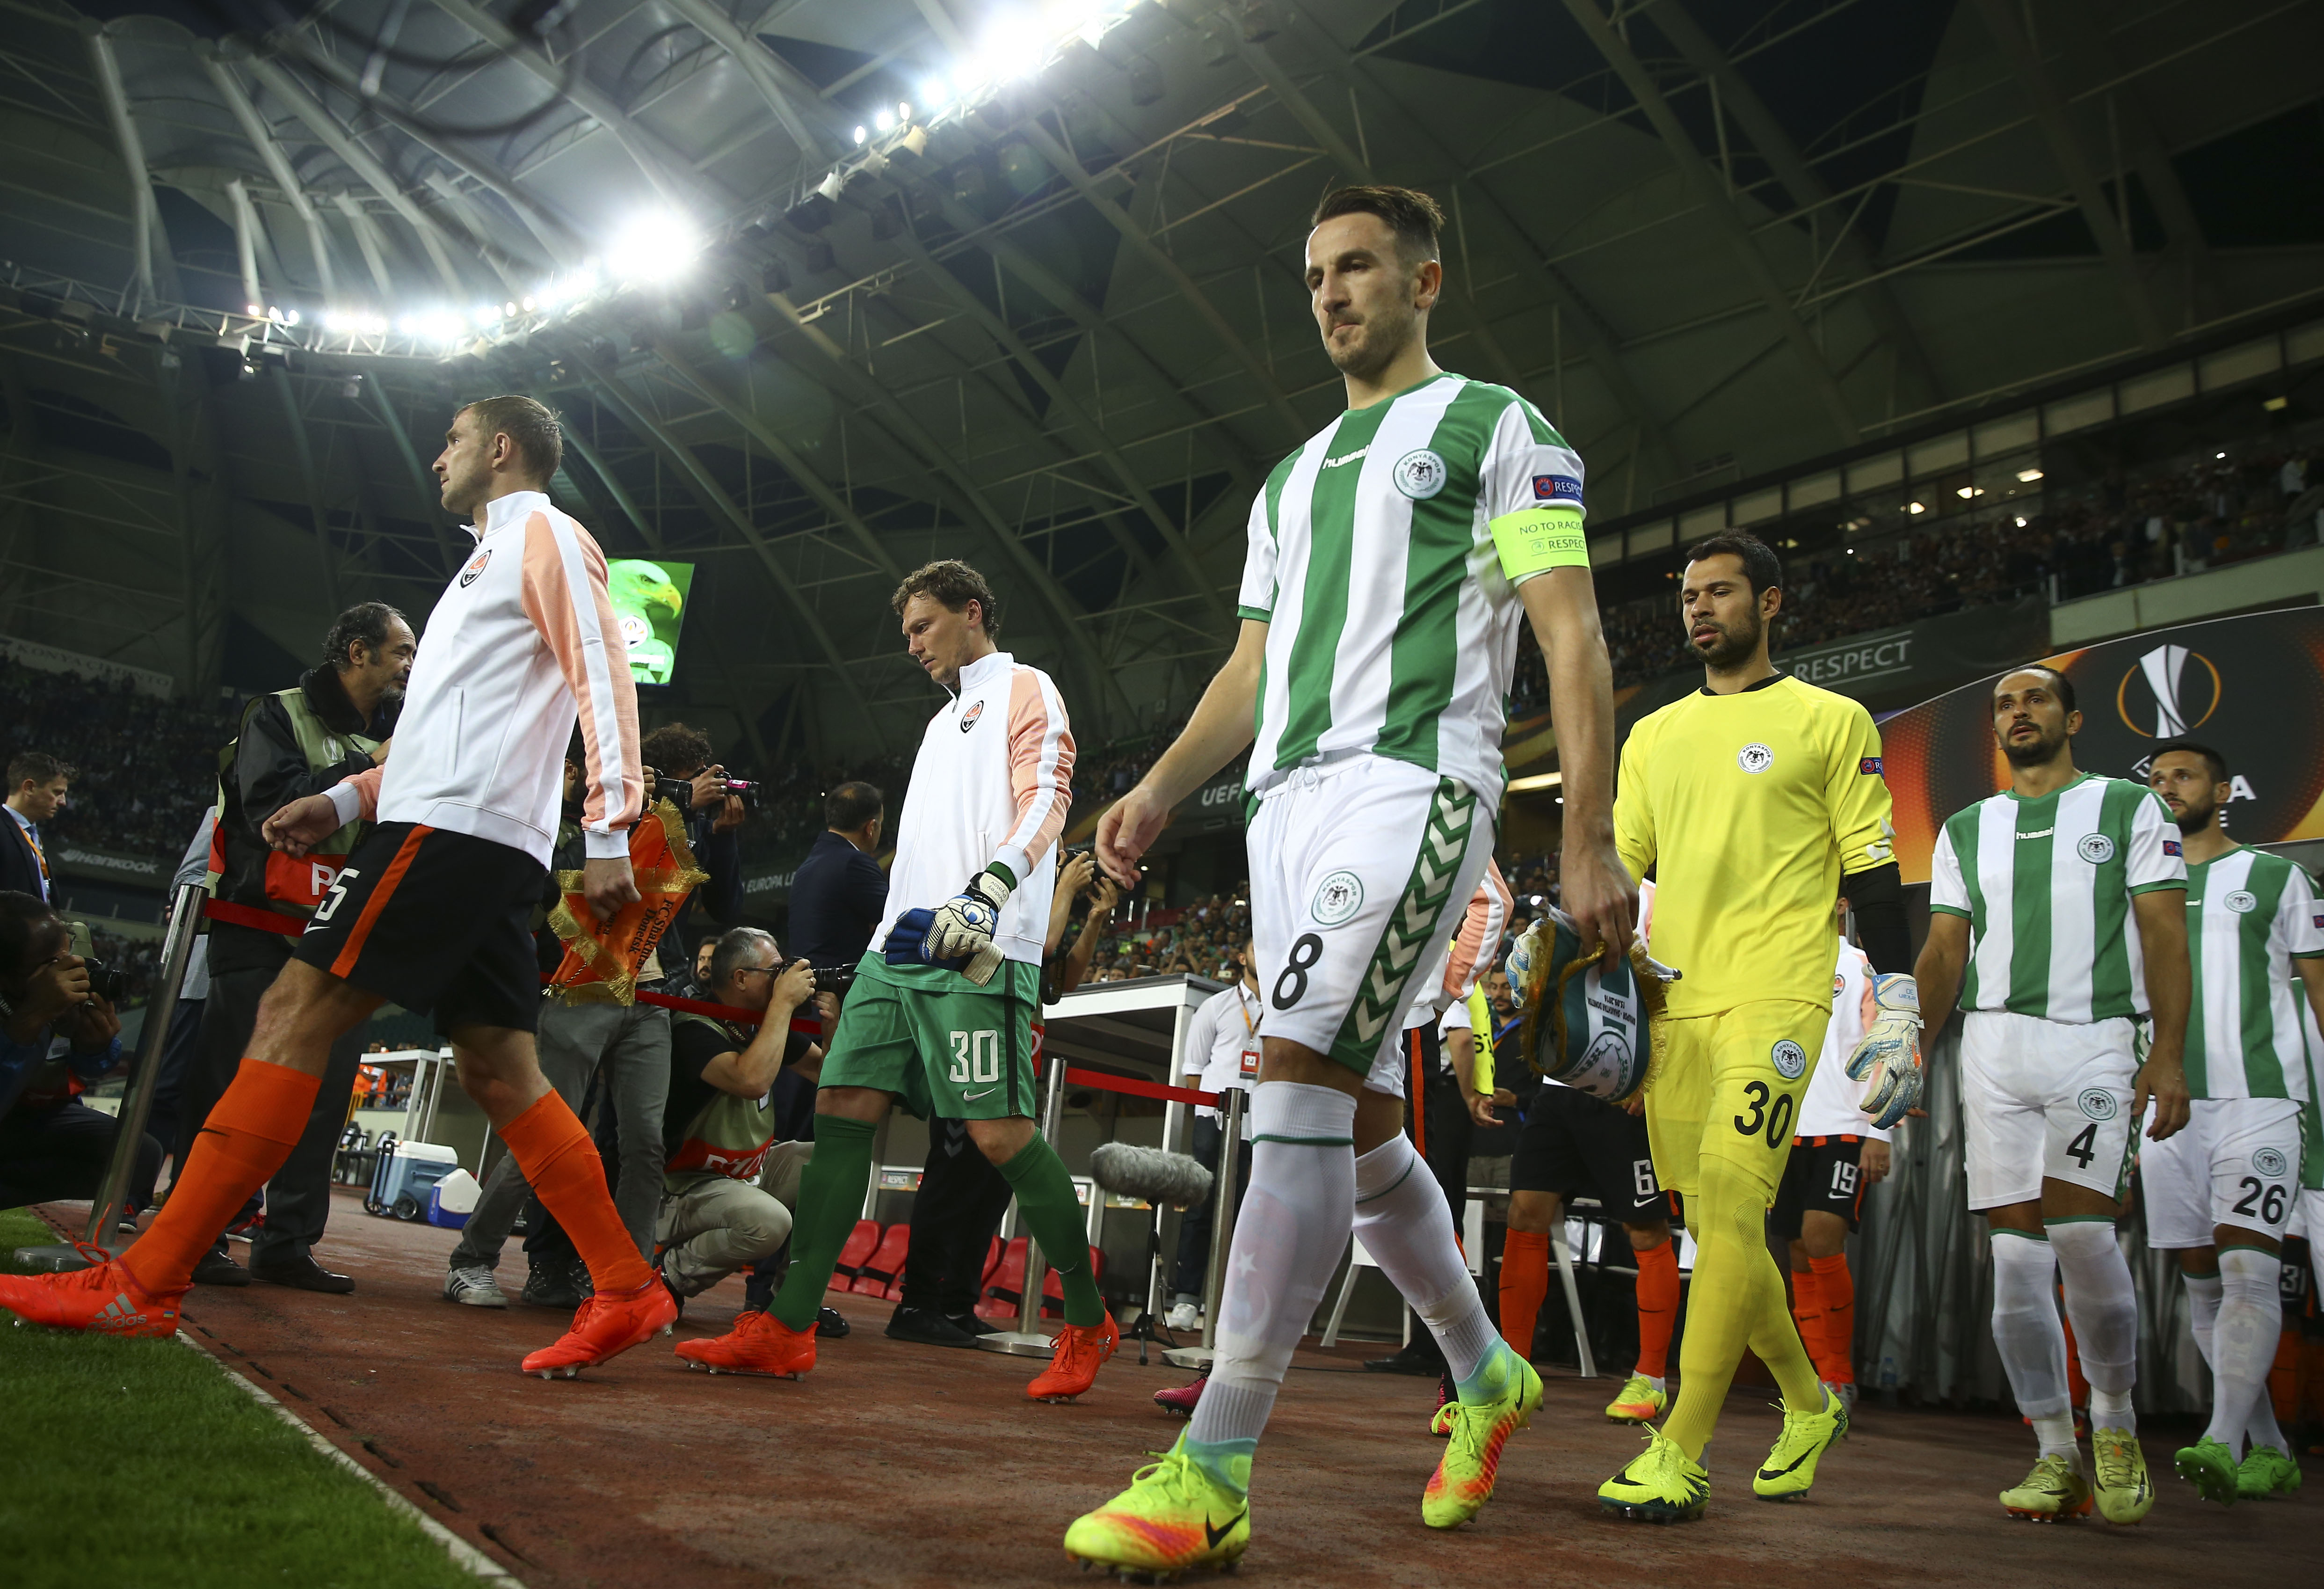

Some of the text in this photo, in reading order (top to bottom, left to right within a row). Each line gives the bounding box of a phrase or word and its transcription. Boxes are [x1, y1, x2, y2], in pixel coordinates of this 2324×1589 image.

[1322, 444, 1370, 470] hummel
[1403, 453, 1441, 474] KONYASPOR
[1519, 524, 1538, 535] NO
[1540, 522, 1555, 531] TO
[1794, 639, 1912, 682] RESPECT
[1743, 745, 1771, 758] KONYASPOR
[1201, 782, 1242, 807] UEF
[315, 867, 361, 921] 5
[987, 885, 1004, 903] Andrey
[1322, 877, 1357, 897] KONYASPOR
[659, 898, 675, 918] FC
[628, 907, 657, 955] Donetsk
[1272, 933, 1323, 1010] 8
[1604, 994, 1625, 1009] 15.09.2016
[949, 1029, 998, 1083] 30
[1777, 1043, 1802, 1060] KONYASPOR
[1734, 1081, 1794, 1149] 30
[2066, 1123, 2097, 1170] 4
[1633, 1159, 1655, 1195] 6
[1831, 1159, 1859, 1194] 19
[2232, 1176, 2287, 1225] 26
[87, 1314, 147, 1330] adidas
